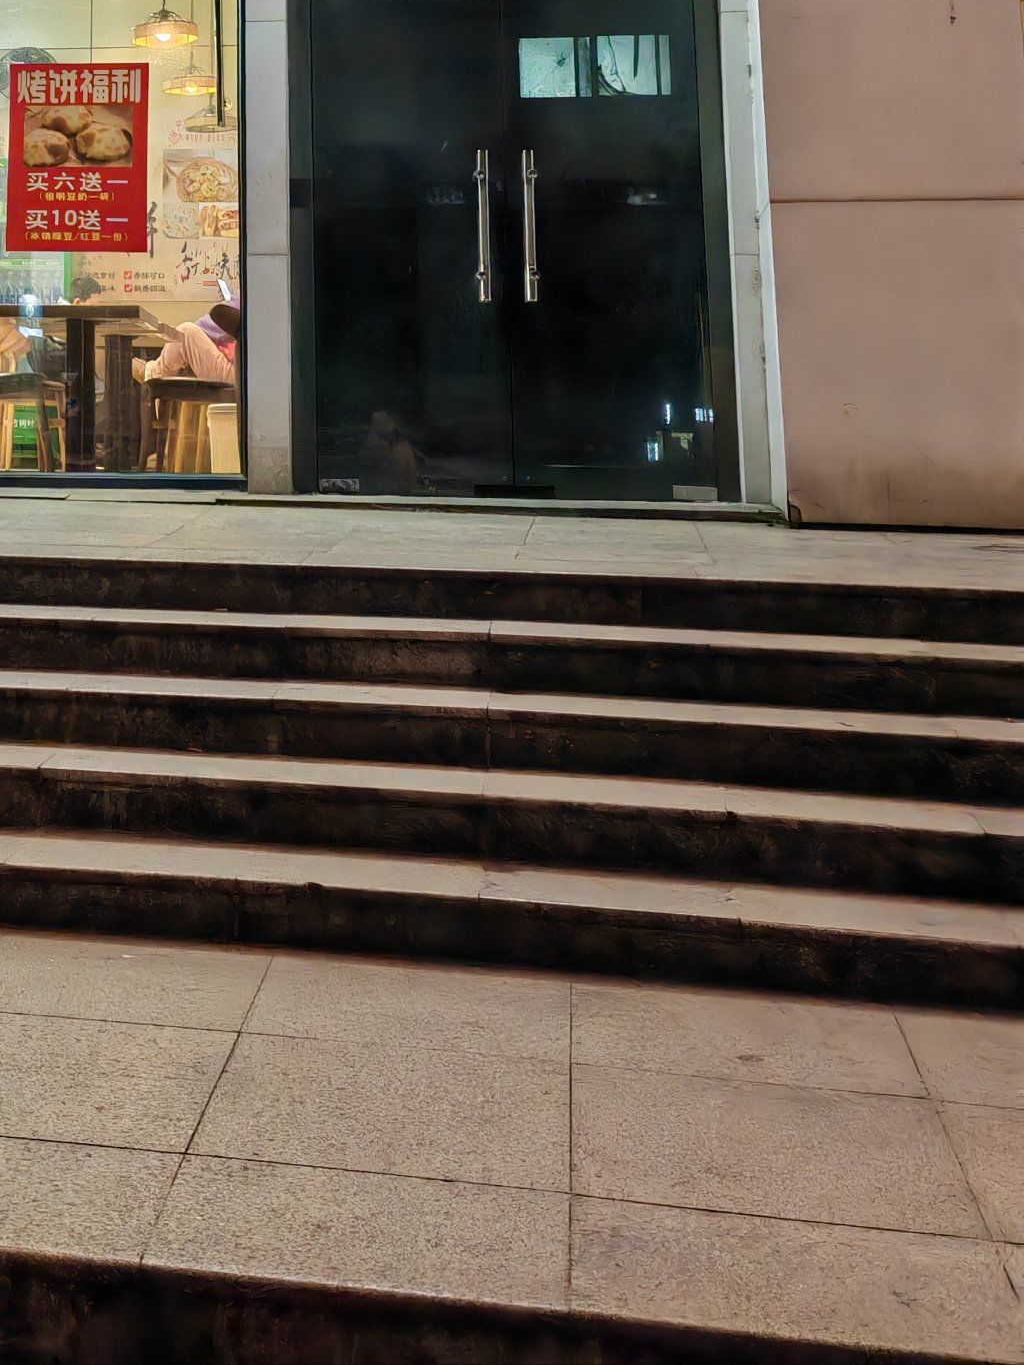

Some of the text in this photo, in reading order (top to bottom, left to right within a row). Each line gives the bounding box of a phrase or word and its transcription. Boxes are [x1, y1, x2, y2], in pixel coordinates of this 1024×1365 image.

[17, 68, 142, 104] 烤饼福利
[27, 172, 129, 191] 买六送一
[24, 209, 129, 230] 买10送一
